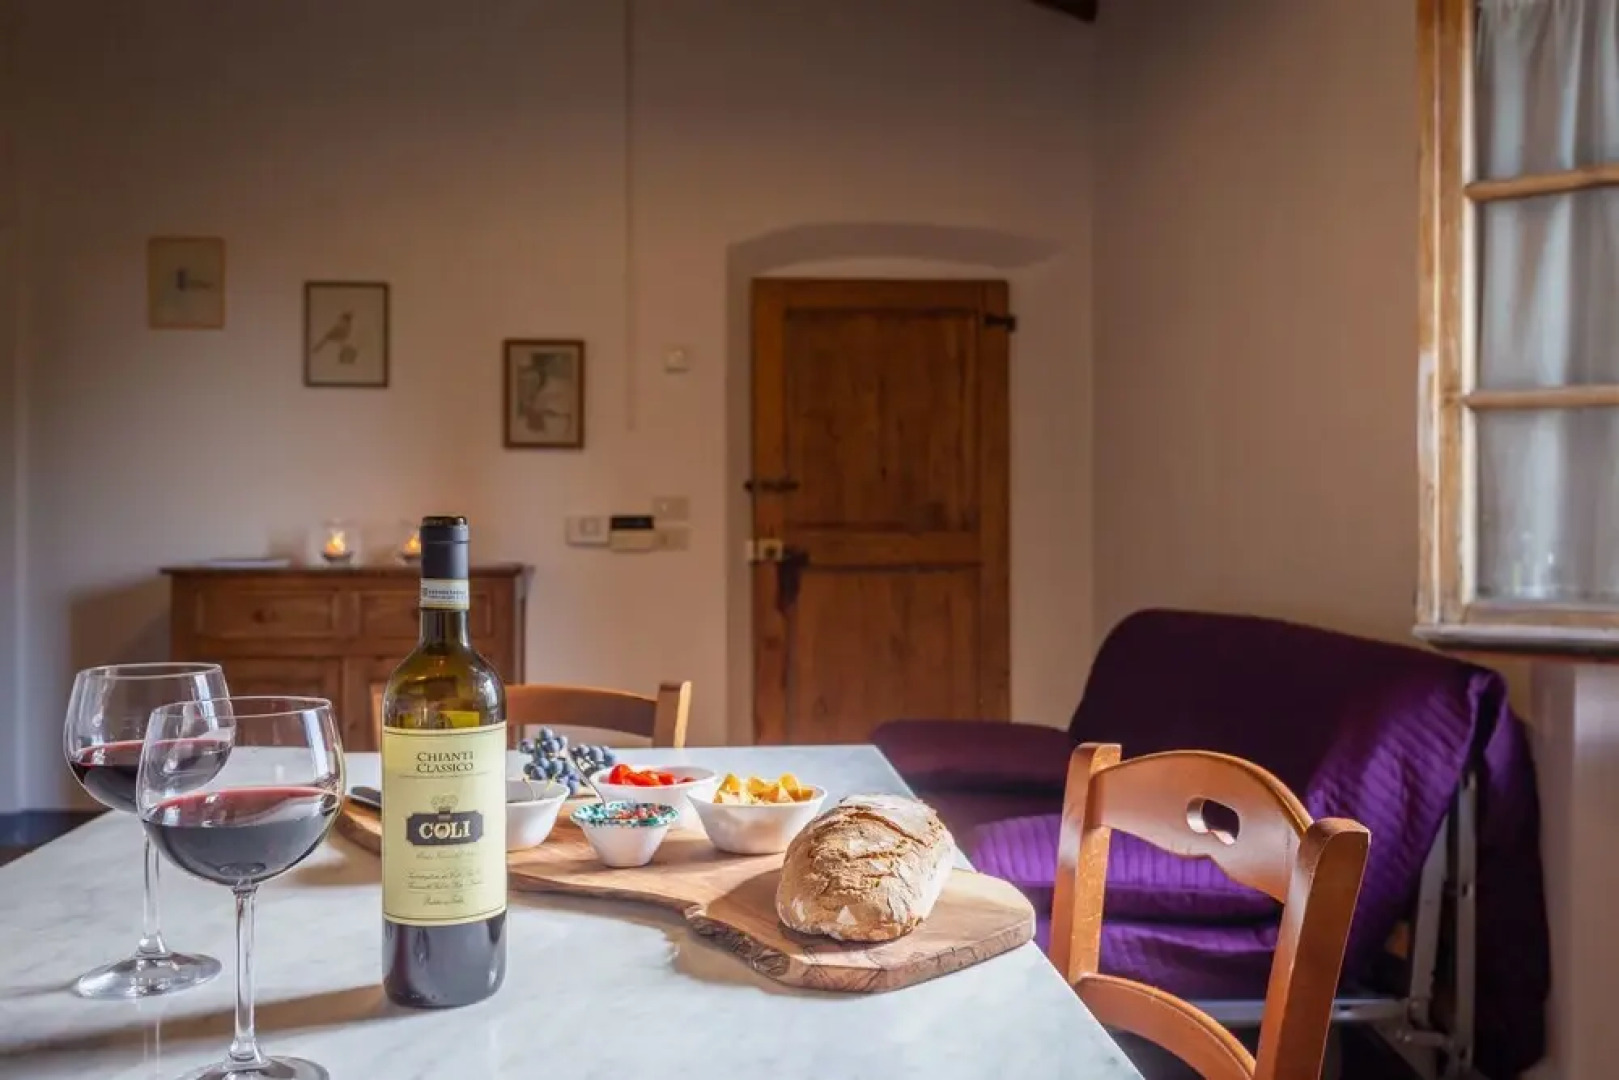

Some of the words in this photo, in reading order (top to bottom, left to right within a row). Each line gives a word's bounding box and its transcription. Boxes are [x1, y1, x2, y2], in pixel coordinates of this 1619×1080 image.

[417, 751, 474, 762] CHIANTI
[416, 762, 474, 773] CLASSICO
[418, 820, 471, 840] COLI
